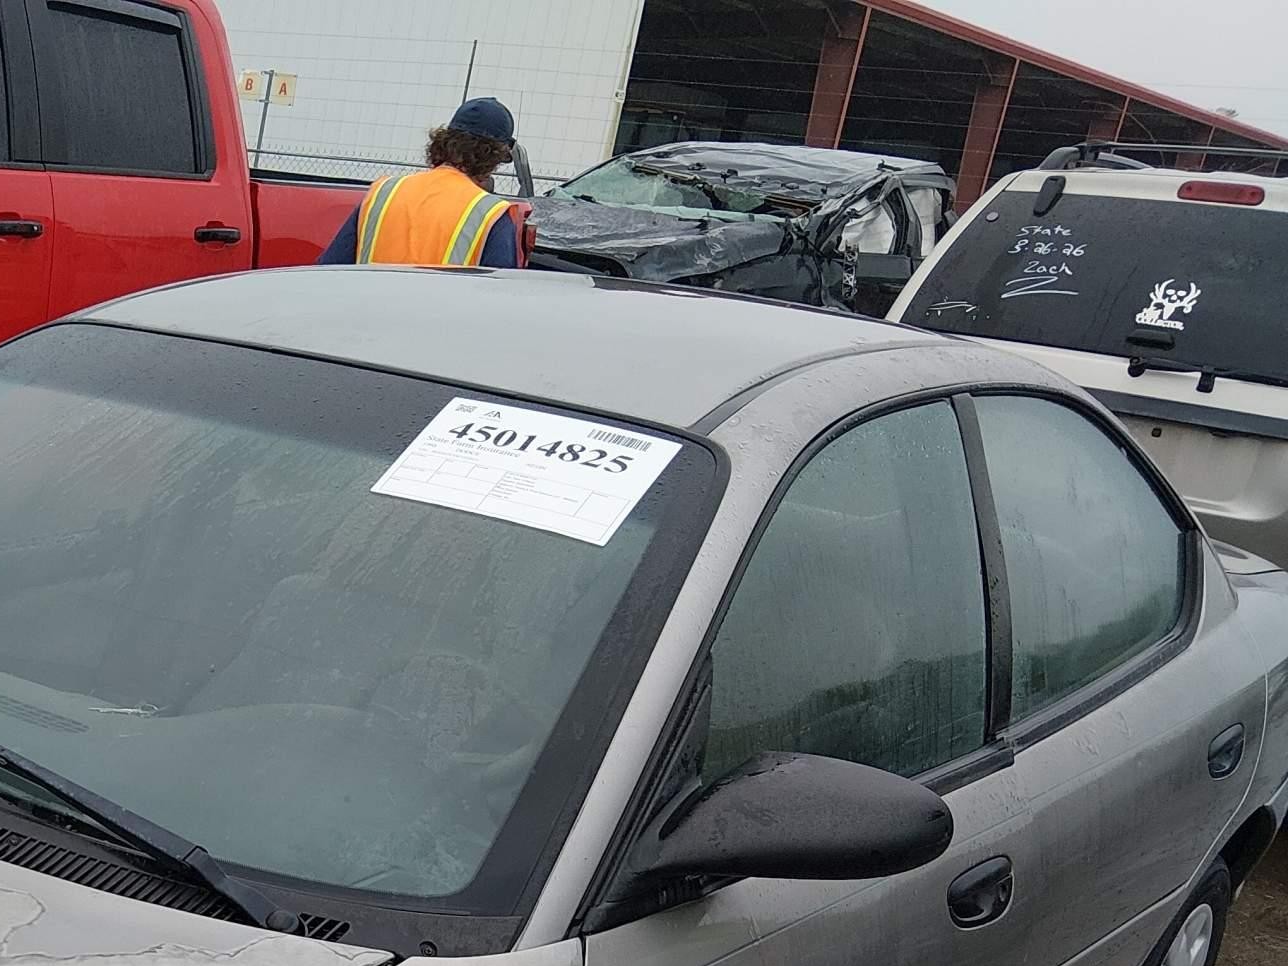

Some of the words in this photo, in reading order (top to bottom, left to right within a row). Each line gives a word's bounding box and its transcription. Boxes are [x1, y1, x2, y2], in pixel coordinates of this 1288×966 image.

[245, 78, 253, 91] B
[279, 82, 287, 95] A
[1015, 225, 1072, 236] State
[1024, 261, 1073, 275] Zach
[448, 422, 635, 473] 45014825
